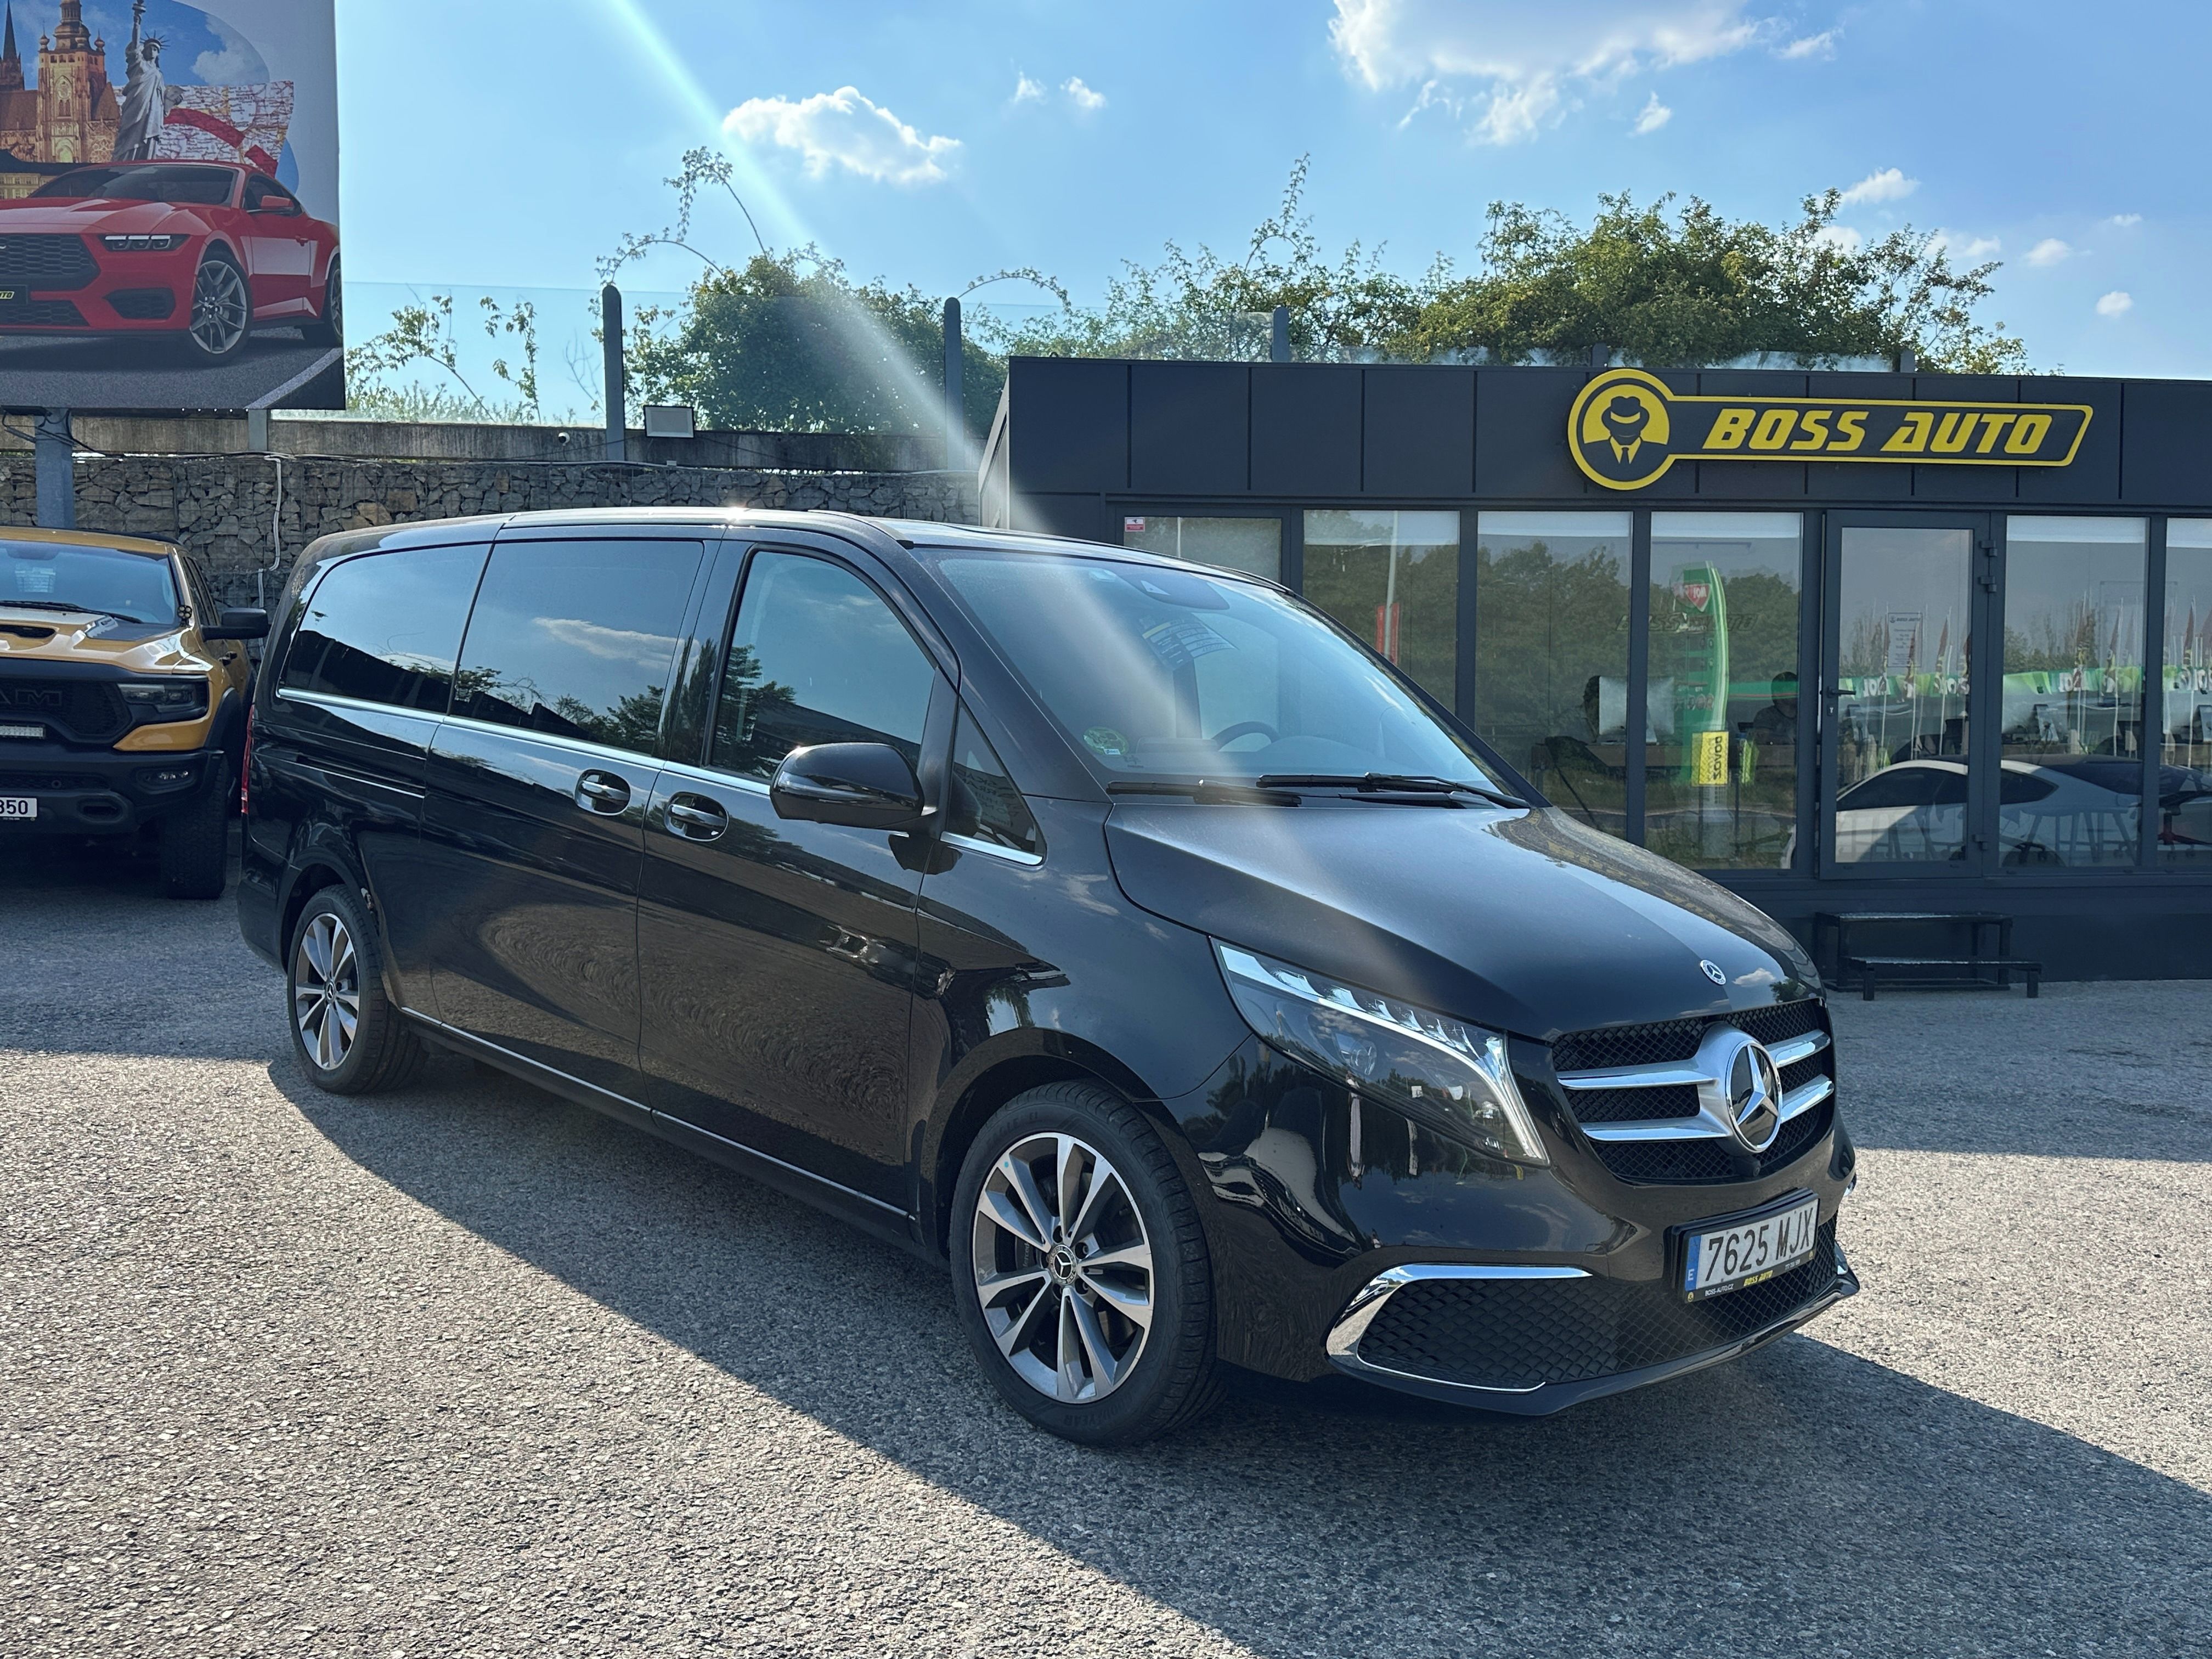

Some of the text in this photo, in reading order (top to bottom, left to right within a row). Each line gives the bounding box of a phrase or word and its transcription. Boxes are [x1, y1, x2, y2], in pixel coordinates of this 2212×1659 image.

[1702, 409, 2053, 454] BOSS AUTO
[1705, 1207, 1813, 1282] 7625 MJX
[1688, 1268, 1695, 1281] E
